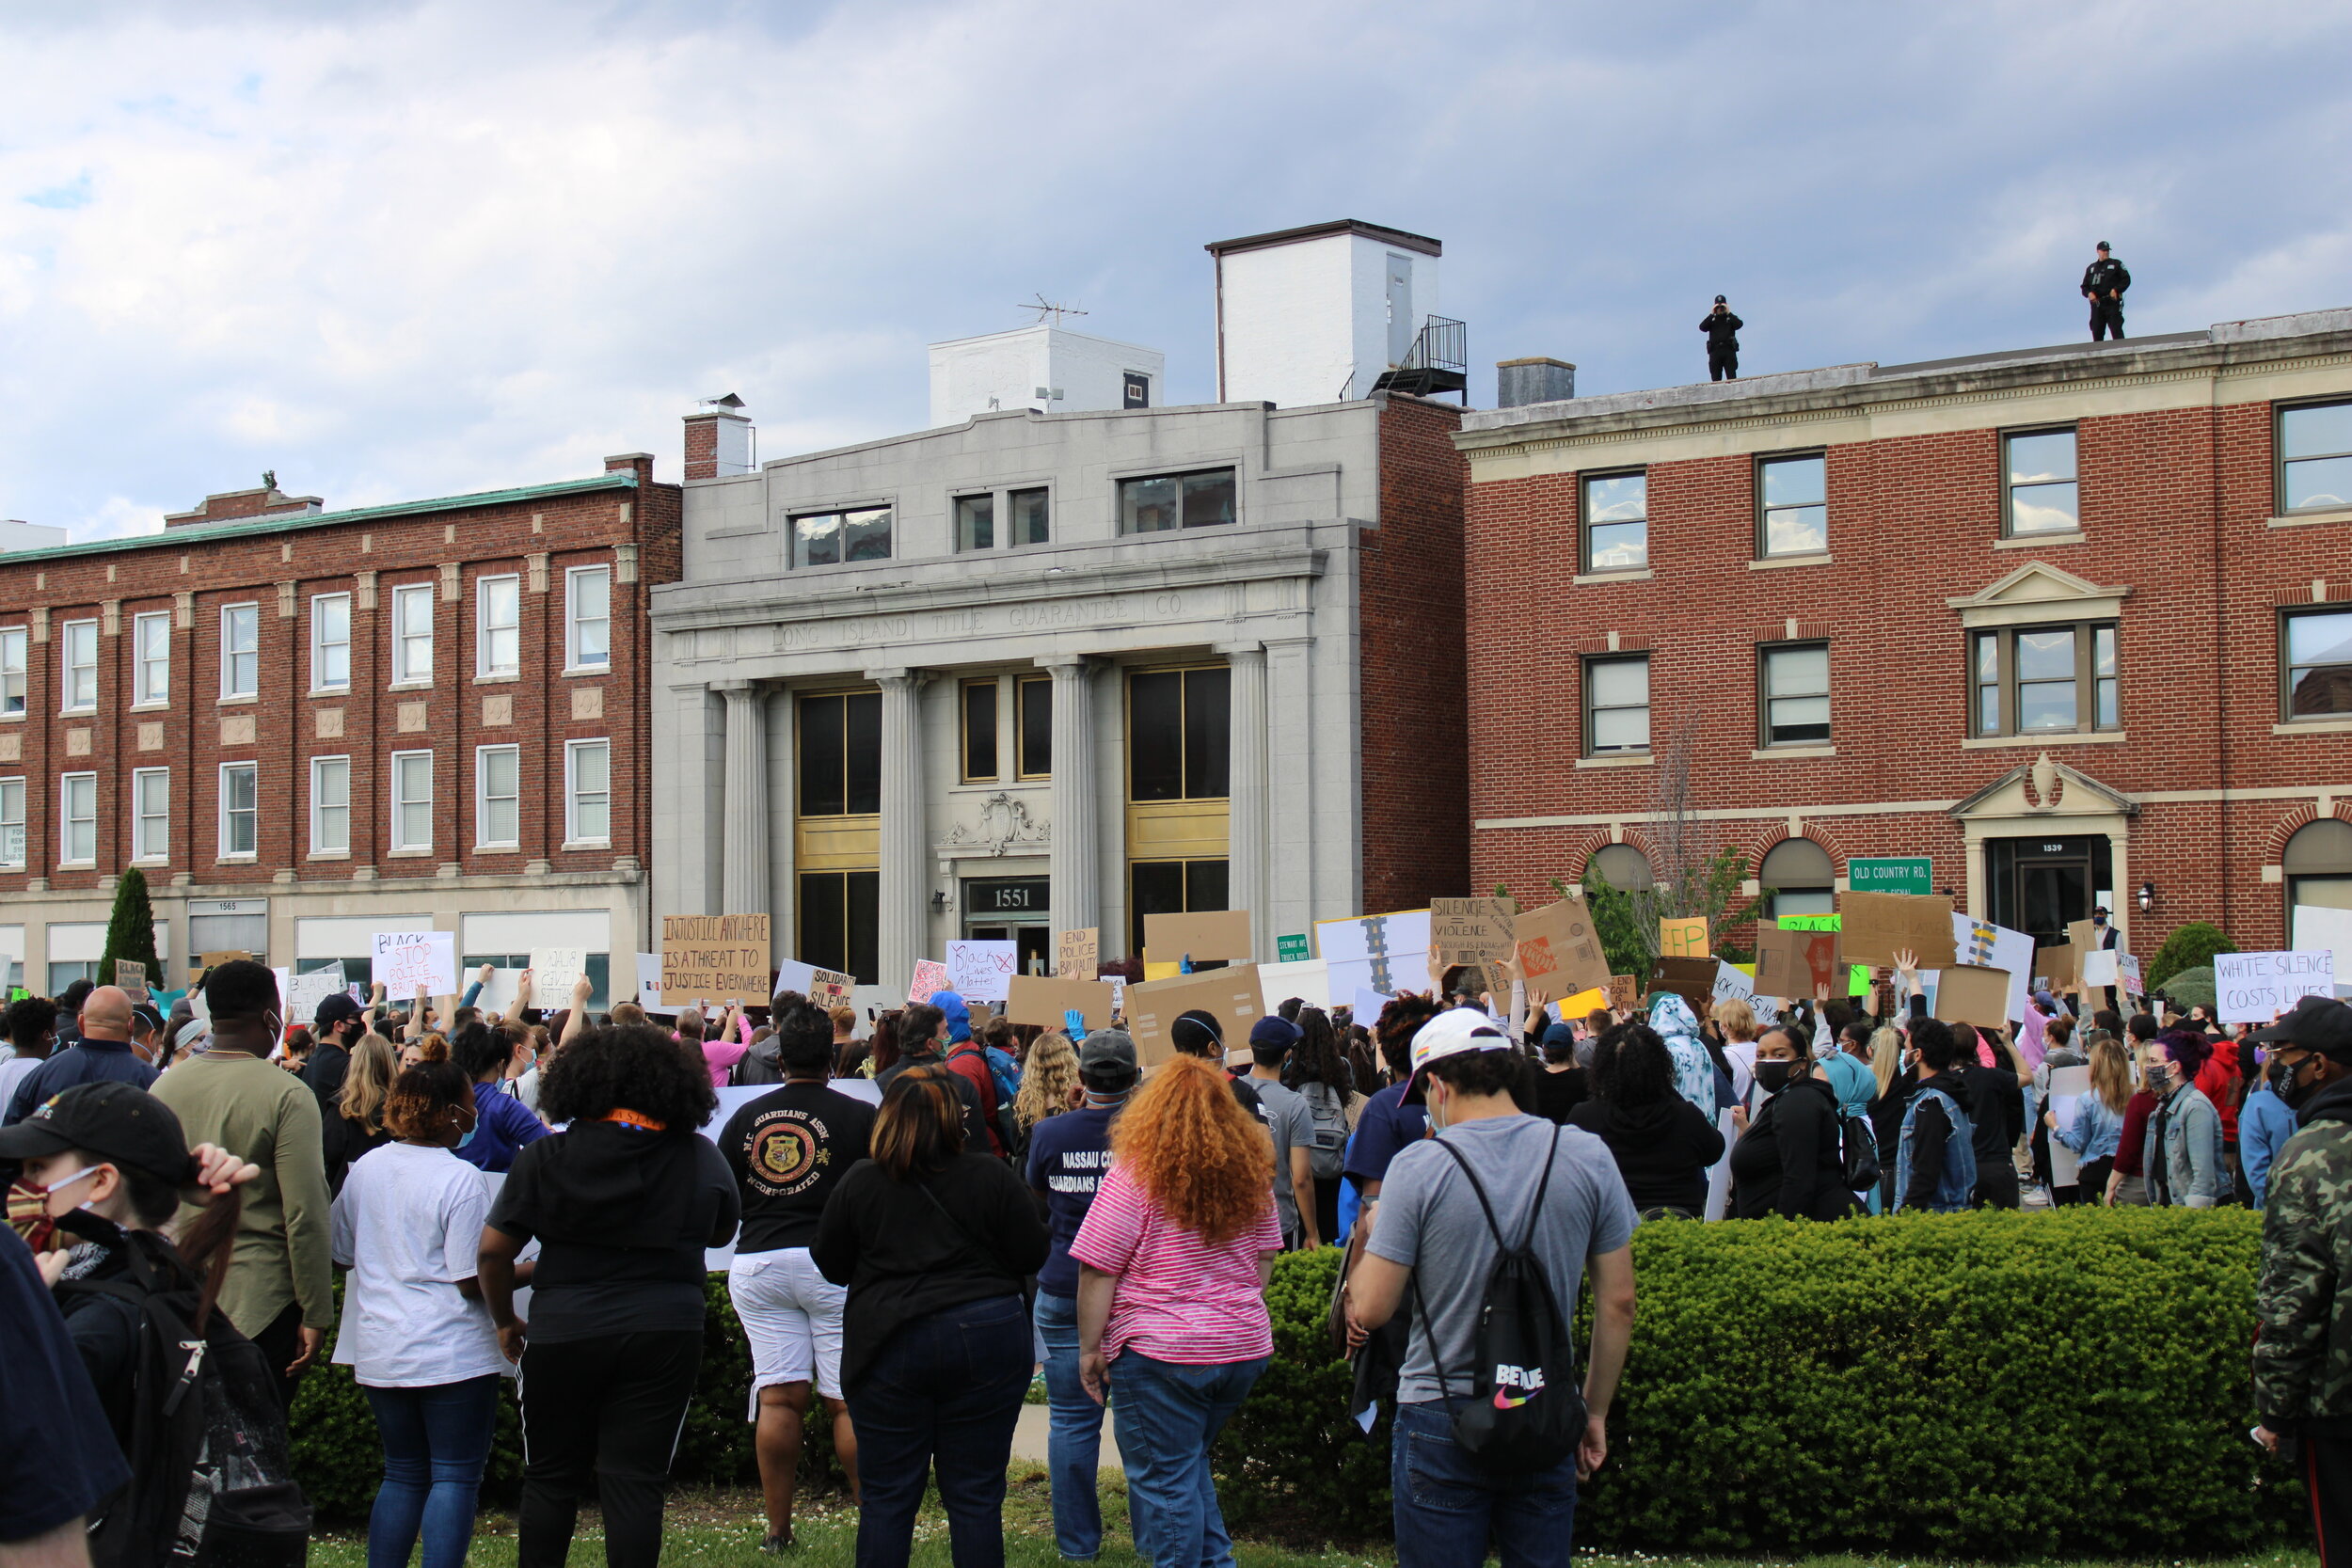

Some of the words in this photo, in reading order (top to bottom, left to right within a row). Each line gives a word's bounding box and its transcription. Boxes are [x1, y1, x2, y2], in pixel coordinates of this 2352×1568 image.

[772, 626, 818, 647] LONG
[842, 618, 908, 641] ISLAND
[932, 611, 984, 633] TITLE
[1009, 599, 1128, 626] GUARANTEE
[1155, 594, 1185, 614] CO.
[2043, 844, 2062, 852] 1539
[1854, 867, 1869, 879] OLD
[1873, 866, 1909, 879] COUNTRY
[1914, 865, 1927, 879] RD.
[219, 902, 236, 911] 1565
[994, 888, 1030, 907] 1551
[1433, 899, 1486, 917] SILENCE
[663, 916, 718, 941] INJUSTICE
[720, 915, 768, 942] ANYWHERE
[1066, 930, 1086, 944] END
[1434, 925, 1488, 936] VIOLENCE
[1059, 942, 1096, 958] POLICE
[1279, 940, 1297, 949] STEWART
[1467, 941, 1474, 949] IS
[395, 942, 432, 966] STOP
[663, 951, 678, 968] IS
[681, 951, 689, 968] A
[690, 949, 736, 968] THREAT
[740, 948, 759, 968] TO
[951, 944, 995, 973] Black
[1280, 953, 1295, 961] TRUCK
[389, 964, 431, 981] POLICE
[965, 963, 993, 975] Lives
[1059, 956, 1098, 975] BRUTALITY
[2217, 957, 2268, 978] WHITE
[2275, 955, 2333, 975] SILENCE
[289, 977, 336, 990] BLACK
[664, 972, 710, 990] JUSTICE
[716, 973, 768, 992] EVERYWHERE
[814, 970, 856, 988] SOLIDARITY
[956, 975, 995, 988] Matter
[1617, 976, 1631, 985] END
[2227, 988, 2278, 1009] COSTS
[754, 1109, 808, 1127] GUARDIANS
[809, 1117, 829, 1142] ASSN.
[1062, 1150, 1099, 1168] NASSAU
[1048, 1175, 1095, 1193] GUARDIANS
